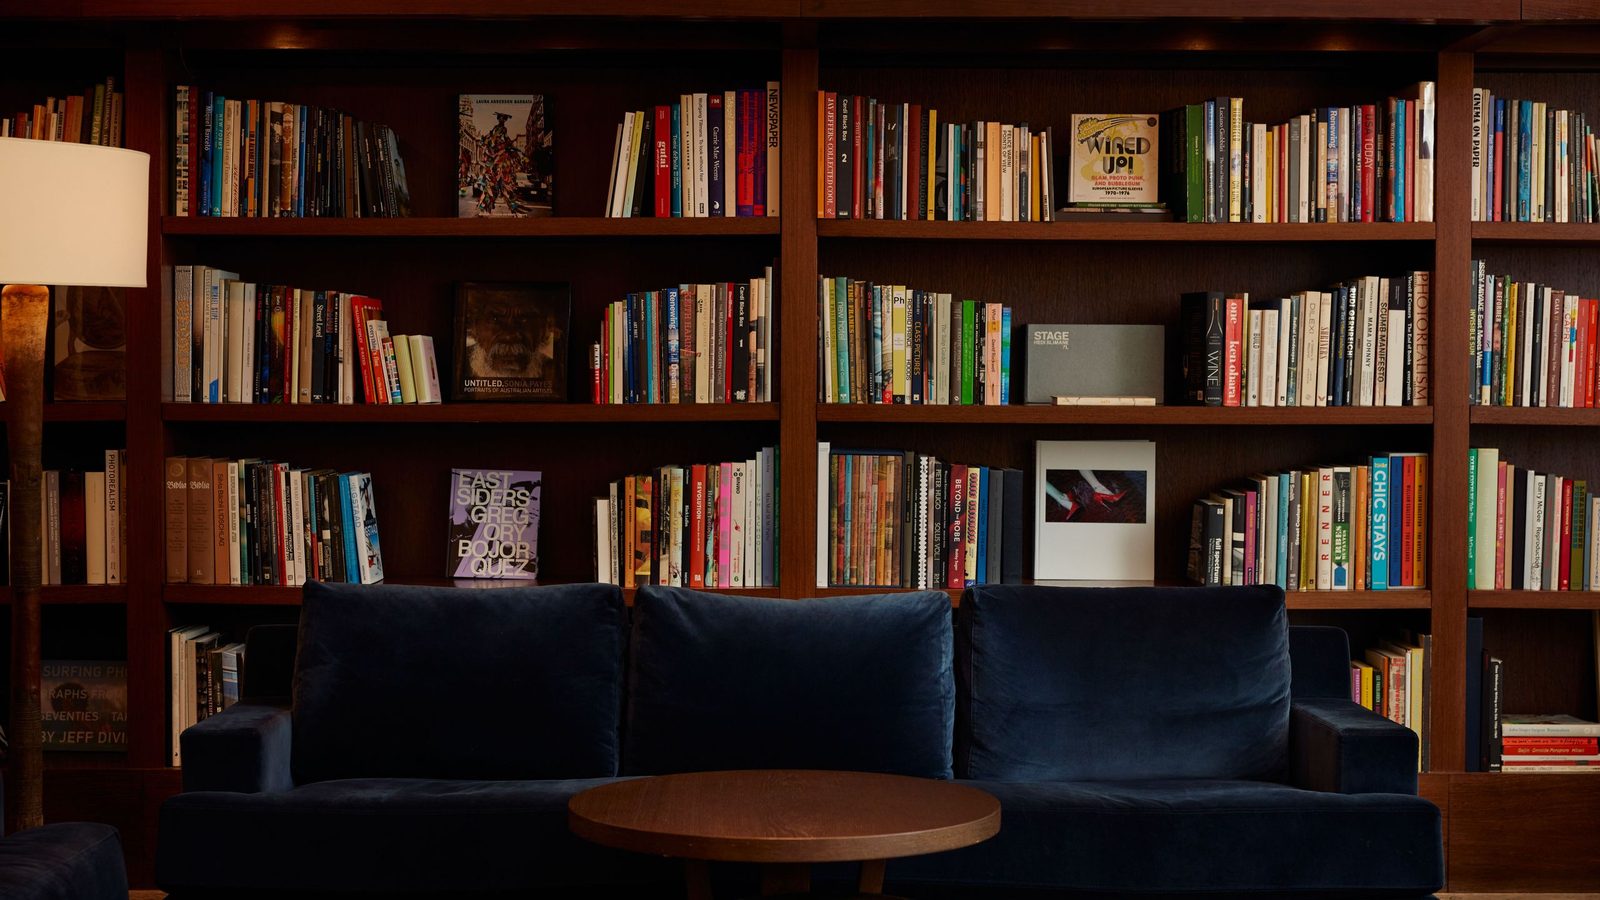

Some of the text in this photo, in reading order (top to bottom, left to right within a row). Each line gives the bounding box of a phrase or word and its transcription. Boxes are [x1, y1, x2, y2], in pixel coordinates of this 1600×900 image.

[205, 105, 213, 128] Miquel
[769, 88, 778, 148] NEWSPAPER
[1472, 93, 1481, 123] CINEMA
[1328, 110, 1337, 149] Renewing
[1364, 113, 1374, 169] USA TODAY
[1472, 126, 1480, 138] ON
[656, 140, 669, 168] gutai
[1102, 156, 1134, 174] UP!
[669, 291, 677, 330] Renewing
[1346, 287, 1356, 357] RUDI GERNREICH
[1034, 330, 1070, 340] STAGE
[1377, 302, 1388, 382] SCUMB MANIFESTO
[1416, 273, 1428, 400] PHOTOREALISM
[1563, 313, 1571, 343] CAPRI
[1228, 302, 1239, 399] one ken ohara
[670, 363, 679, 389] Dream
[1206, 350, 1219, 387] WINE
[458, 472, 513, 489] EAST
[351, 492, 362, 528] GSTAAD
[456, 488, 530, 507] SIDERS
[470, 506, 529, 524] GREG
[1373, 470, 1386, 561] CHIC STAYS
[483, 523, 528, 542] ORY
[1534, 526, 1542, 569] Reproduction
[458, 540, 530, 559] BOJOR
[470, 557, 530, 576] QUEZ
[1212, 550, 1221, 584] spectrum
[43, 665, 102, 677] SURFING
[60, 731, 96, 744] JEFF
[98, 732, 128, 744] DIVI
